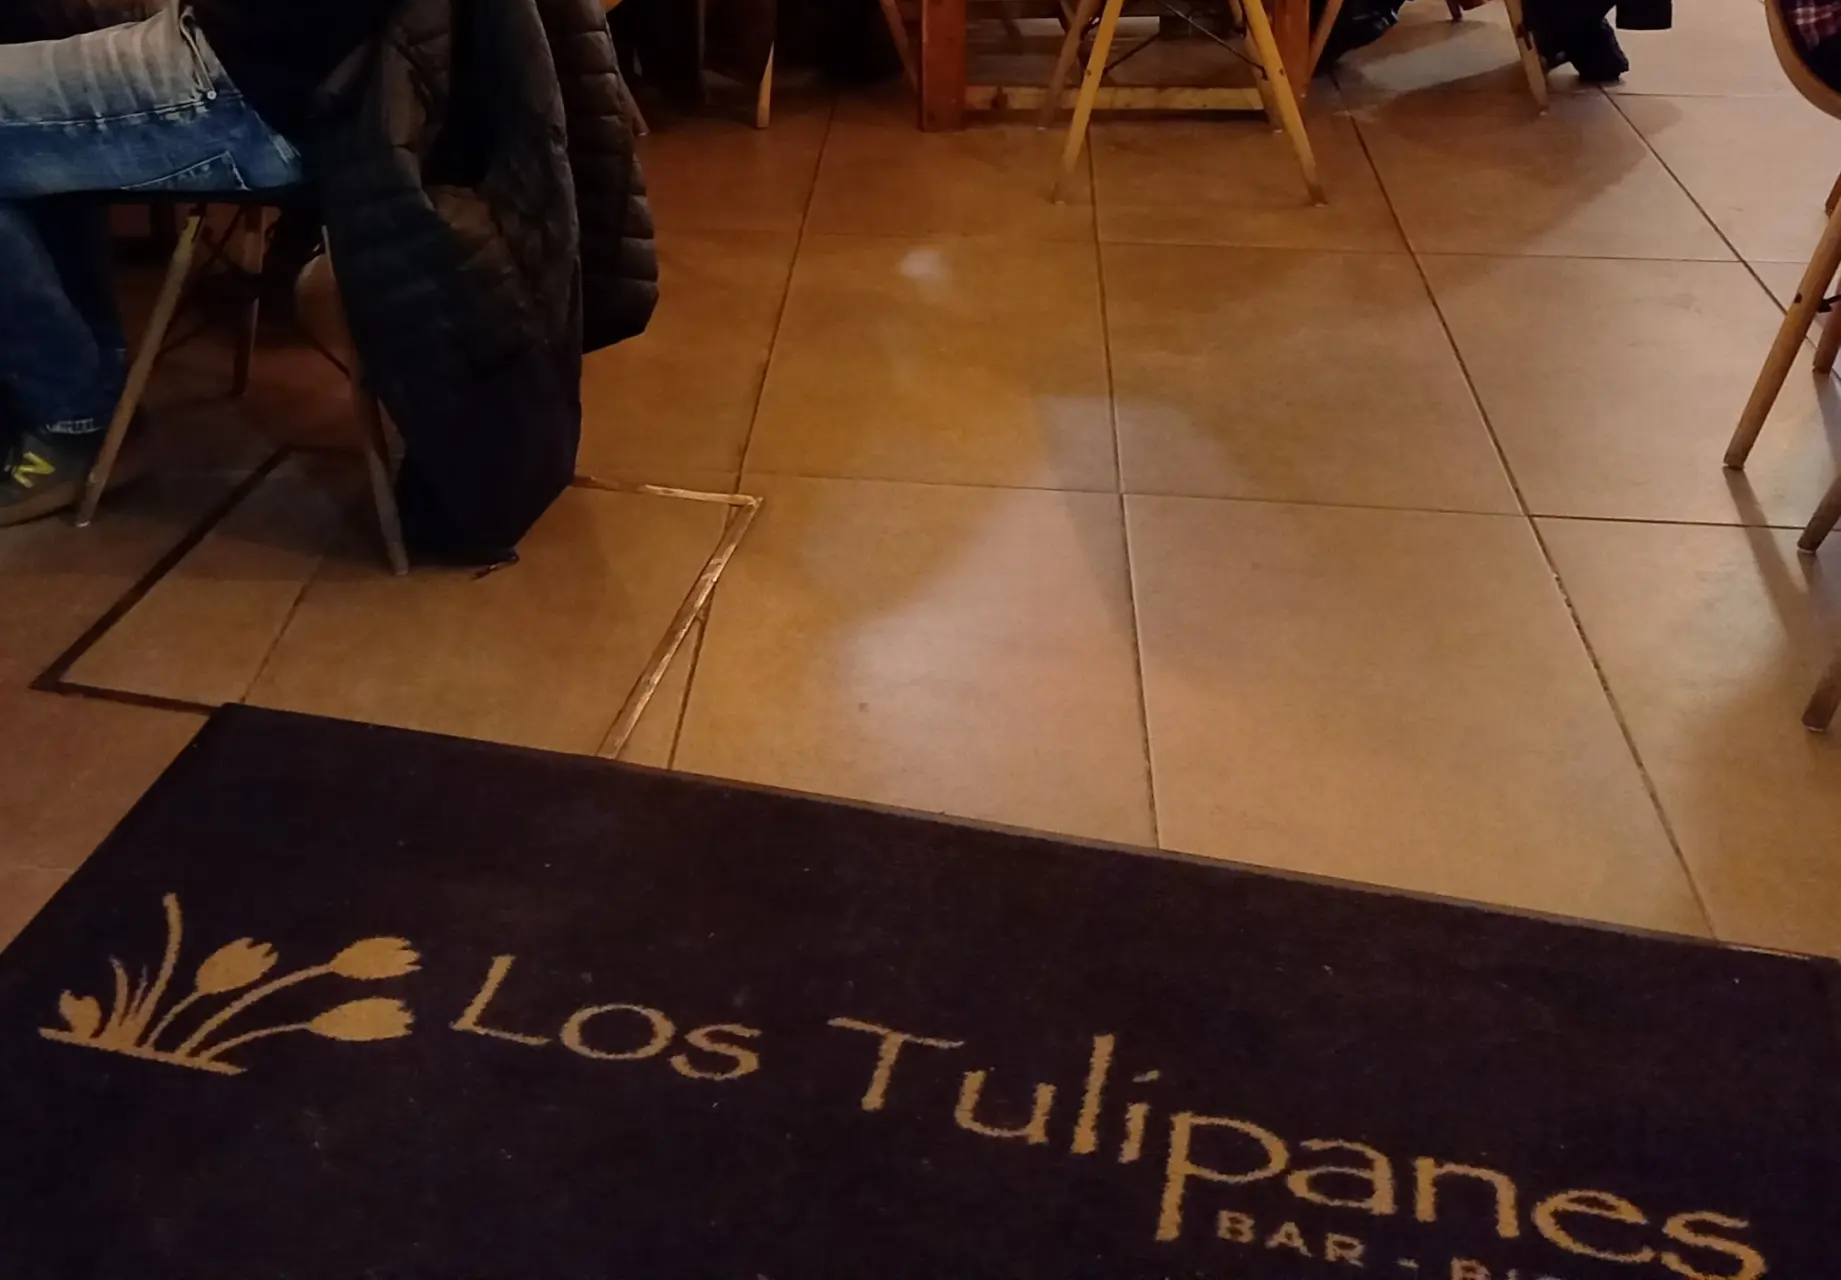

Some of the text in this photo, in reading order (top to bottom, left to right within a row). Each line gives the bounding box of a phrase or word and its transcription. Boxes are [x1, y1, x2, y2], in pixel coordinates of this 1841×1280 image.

[450, 953, 1765, 1280] Los Tulipanes
[1217, 1209, 1366, 1268] BAR
